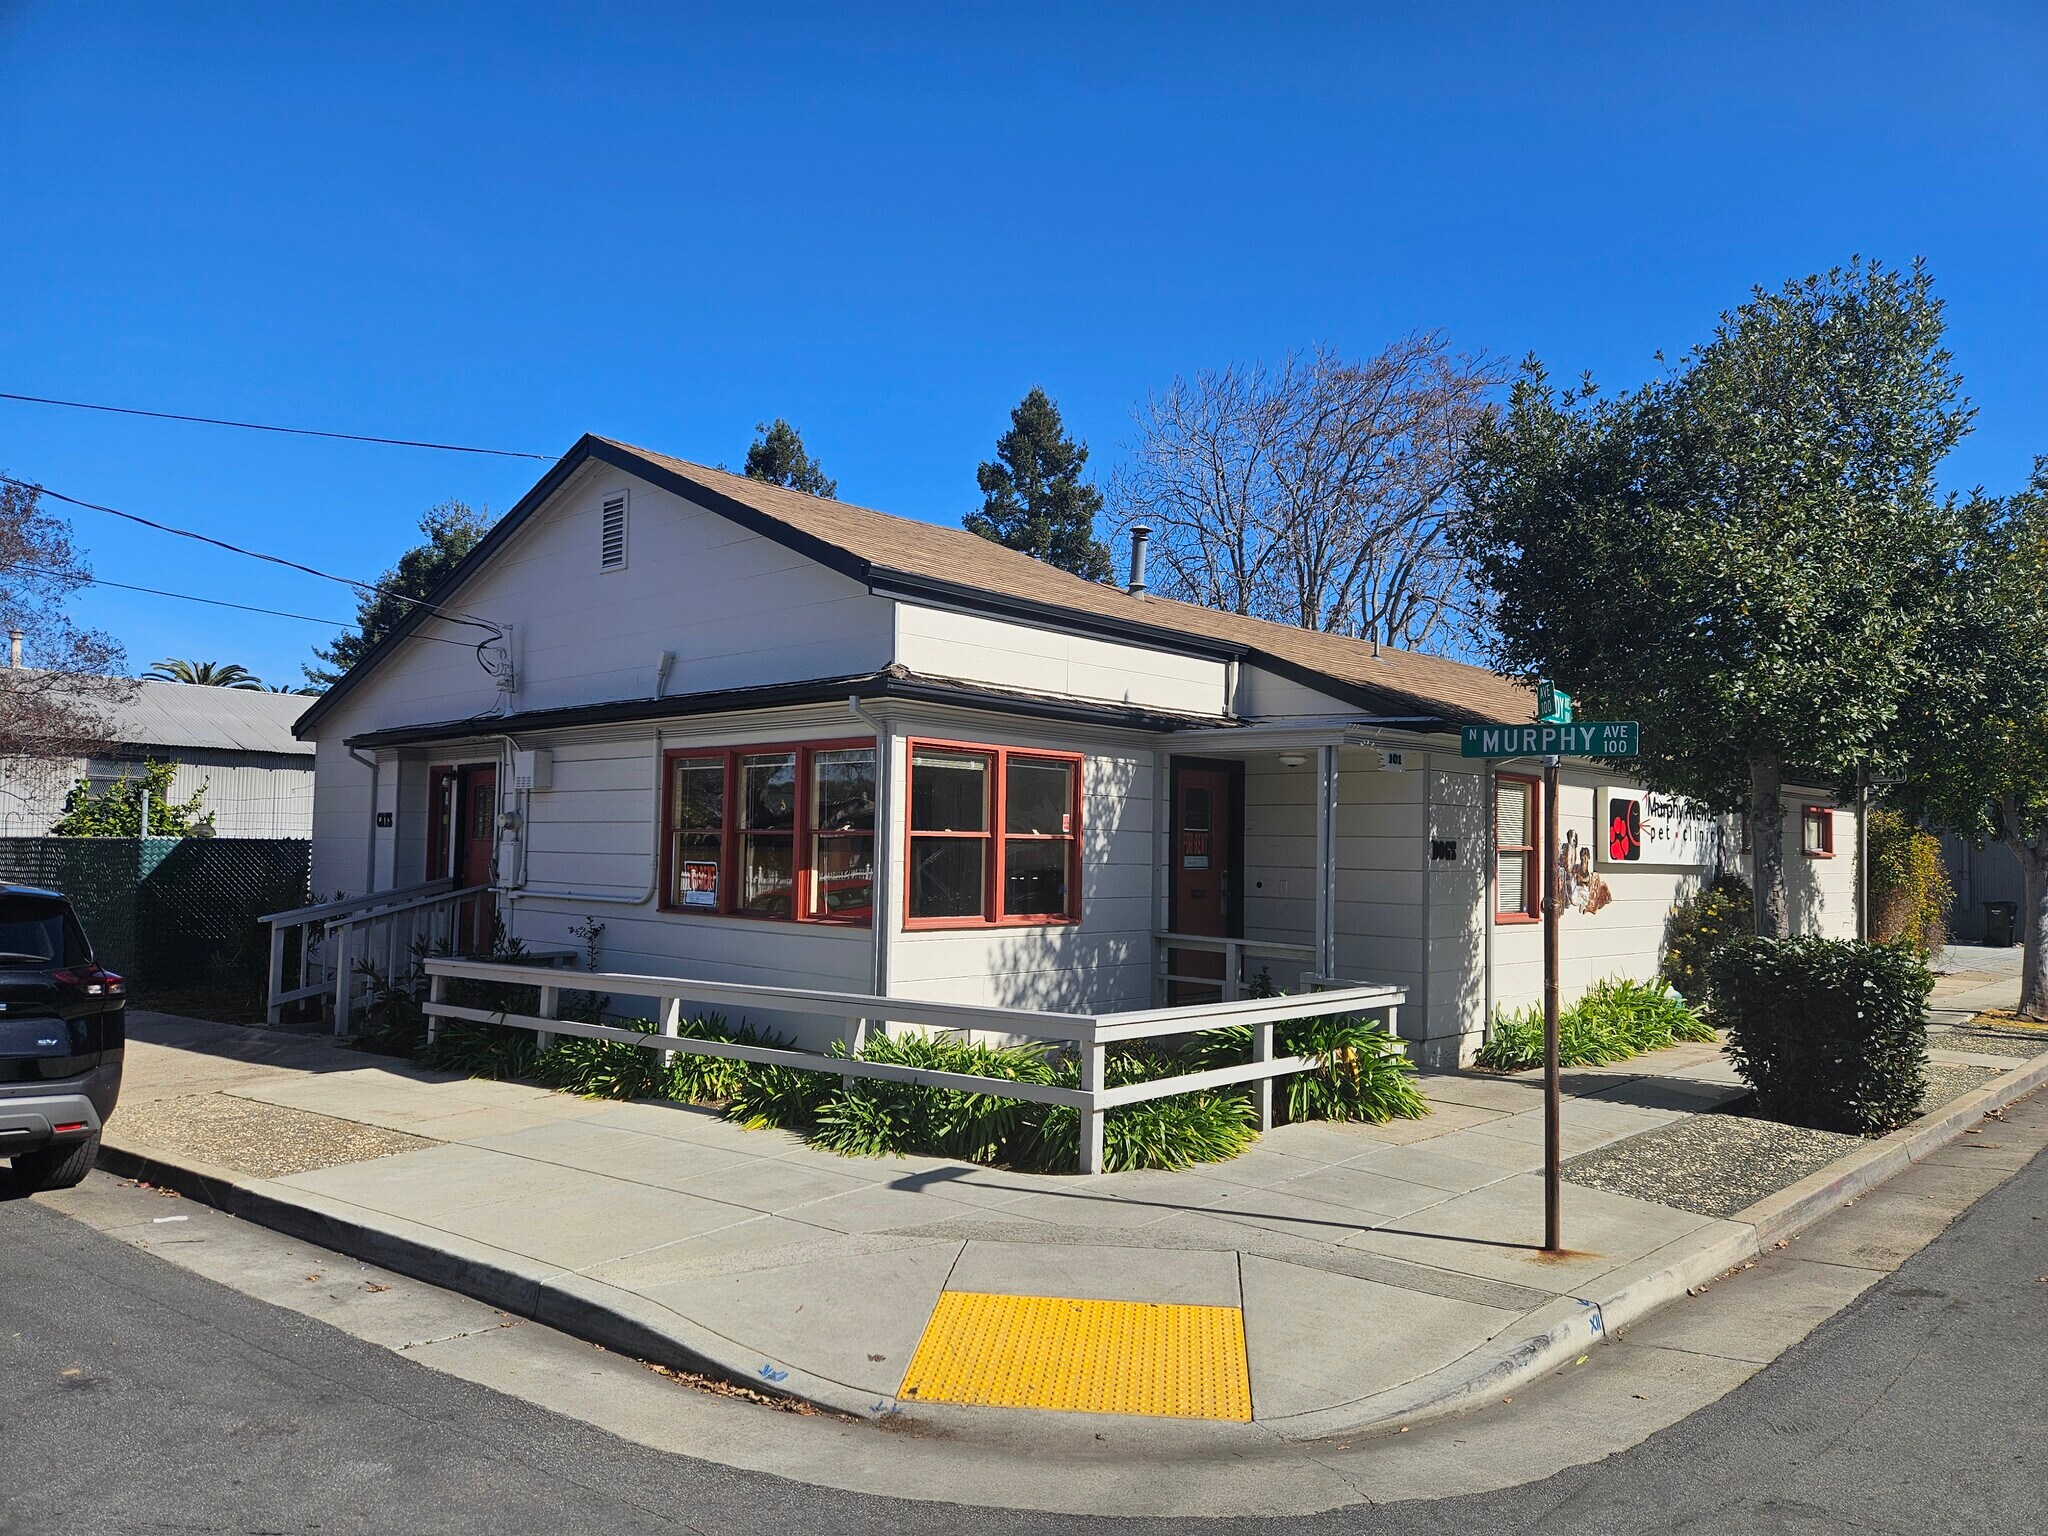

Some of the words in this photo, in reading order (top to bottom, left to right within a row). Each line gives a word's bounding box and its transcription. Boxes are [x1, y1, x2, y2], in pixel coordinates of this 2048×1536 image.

[1540, 684, 1551, 699] AVE
[1541, 700, 1552, 714] 100
[1469, 728, 1477, 740] N
[1483, 727, 1596, 753] MURPHY
[1603, 725, 1628, 738] AVE
[1603, 740, 1628, 753] 100
[1388, 753, 1402, 765] 101
[1648, 796, 1684, 825] Murphy
[1651, 825, 1671, 843] pet
[1683, 826, 1716, 843] clinic
